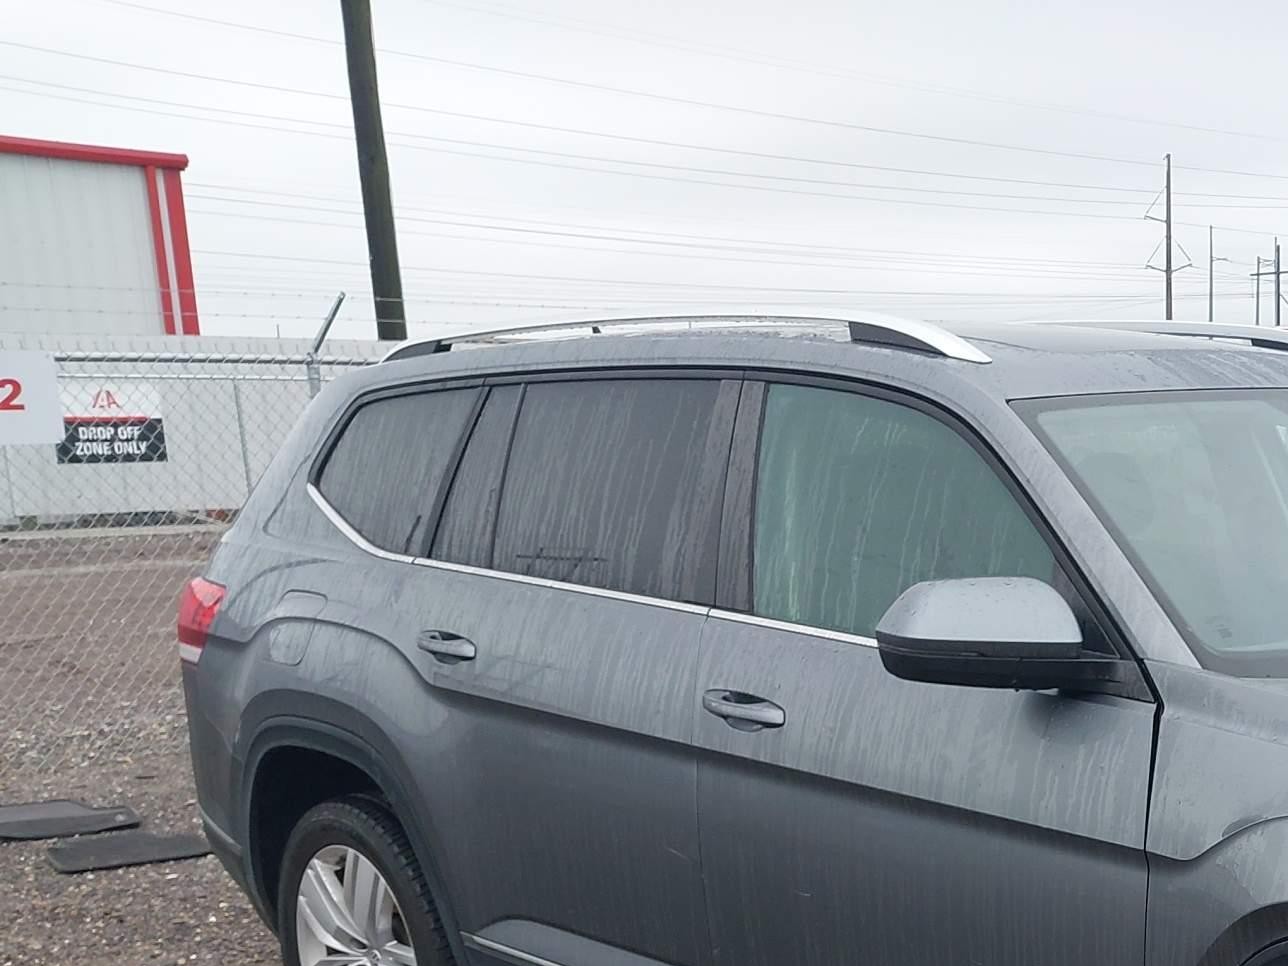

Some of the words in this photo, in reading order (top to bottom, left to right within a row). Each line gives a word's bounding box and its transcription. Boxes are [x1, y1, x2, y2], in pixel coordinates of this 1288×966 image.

[0, 378, 25, 410] 2
[78, 426, 115, 441] DROP
[117, 426, 142, 439] OFF
[75, 441, 112, 455] ZONE
[114, 441, 147, 455] ONLY
